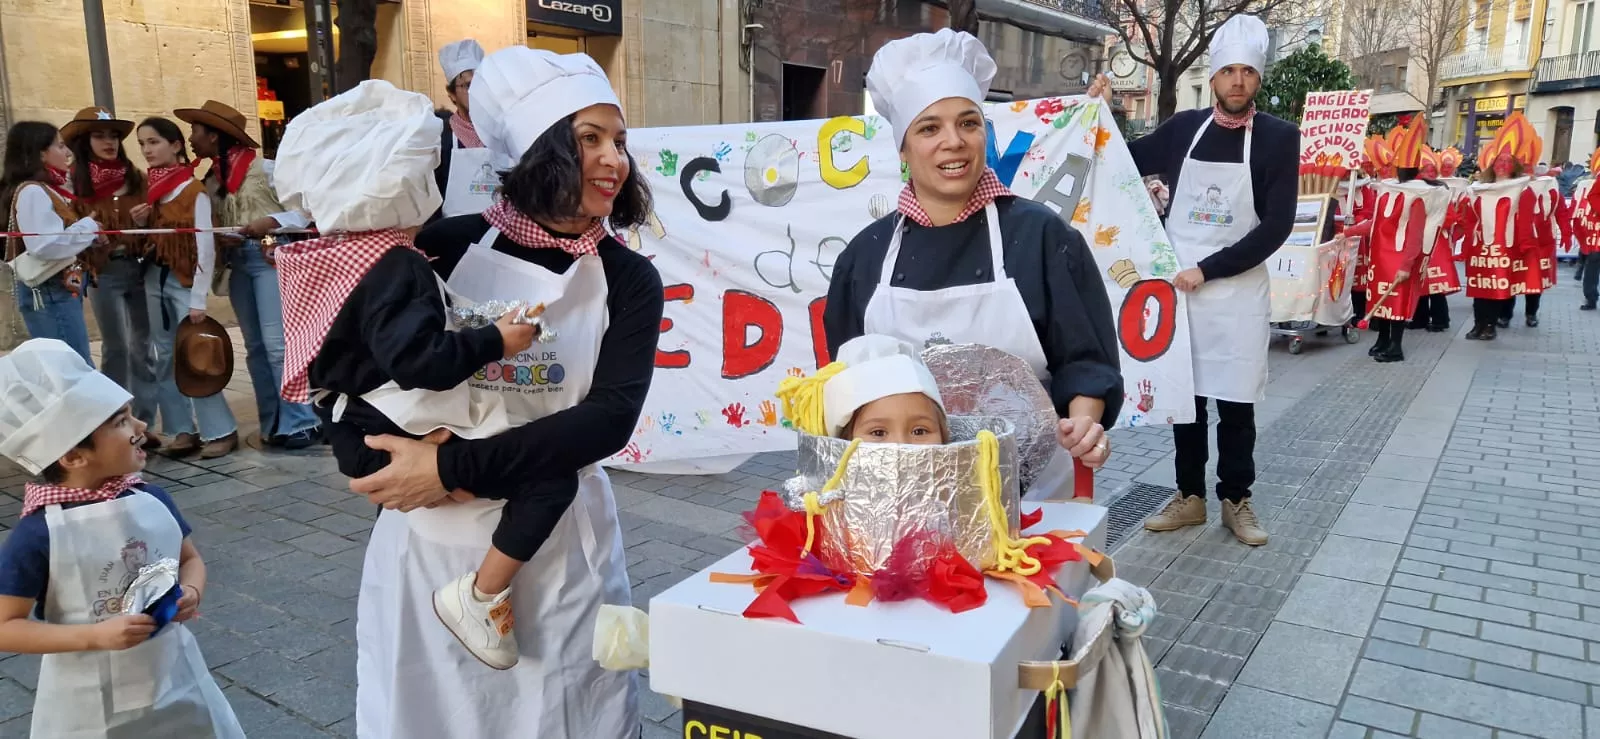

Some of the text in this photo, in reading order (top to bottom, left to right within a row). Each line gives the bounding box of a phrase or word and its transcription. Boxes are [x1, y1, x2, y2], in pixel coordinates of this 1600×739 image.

[832, 60, 843, 84] 17
[1305, 108, 1369, 121] APAGADO
[1301, 122, 1364, 138] VECINOS
[1301, 136, 1361, 168] NCENDIDOS
[1480, 244, 1502, 257] SE
[1470, 253, 1511, 269] ARMÓ
[1512, 260, 1529, 273] EL
[1427, 266, 1448, 279] EL
[542, 352, 557, 361] DE
